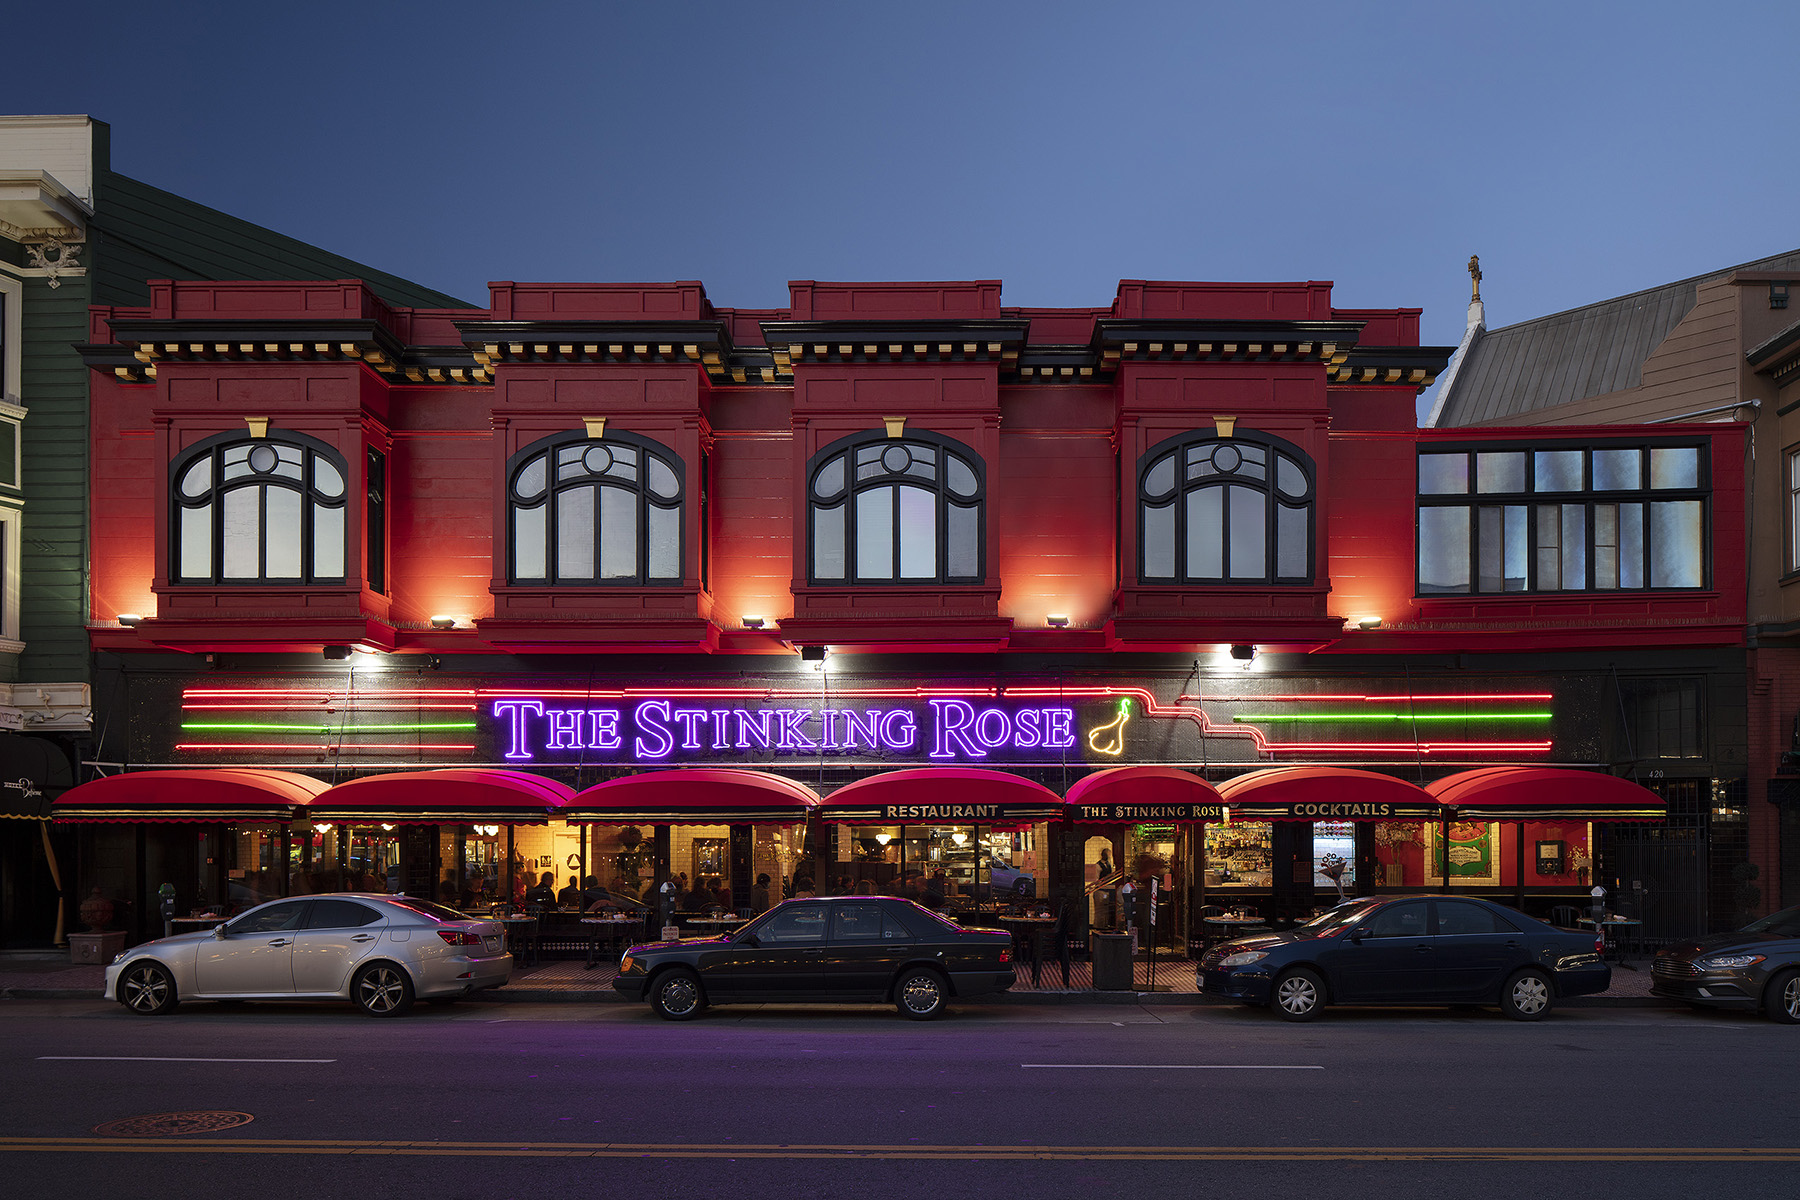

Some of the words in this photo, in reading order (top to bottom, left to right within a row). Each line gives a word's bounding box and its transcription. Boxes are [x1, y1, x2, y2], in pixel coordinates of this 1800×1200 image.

[493, 700, 622, 759] THE
[635, 700, 917, 759] STINKING
[929, 699, 1076, 758] ROSE
[1648, 769, 1664, 778] 420
[887, 804, 999, 818] RESTAURANT
[1080, 805, 1108, 818] THE
[1115, 805, 1186, 818] STINKING
[1192, 804, 1221, 818] ROSE
[1293, 803, 1390, 816] COCKTAILS
